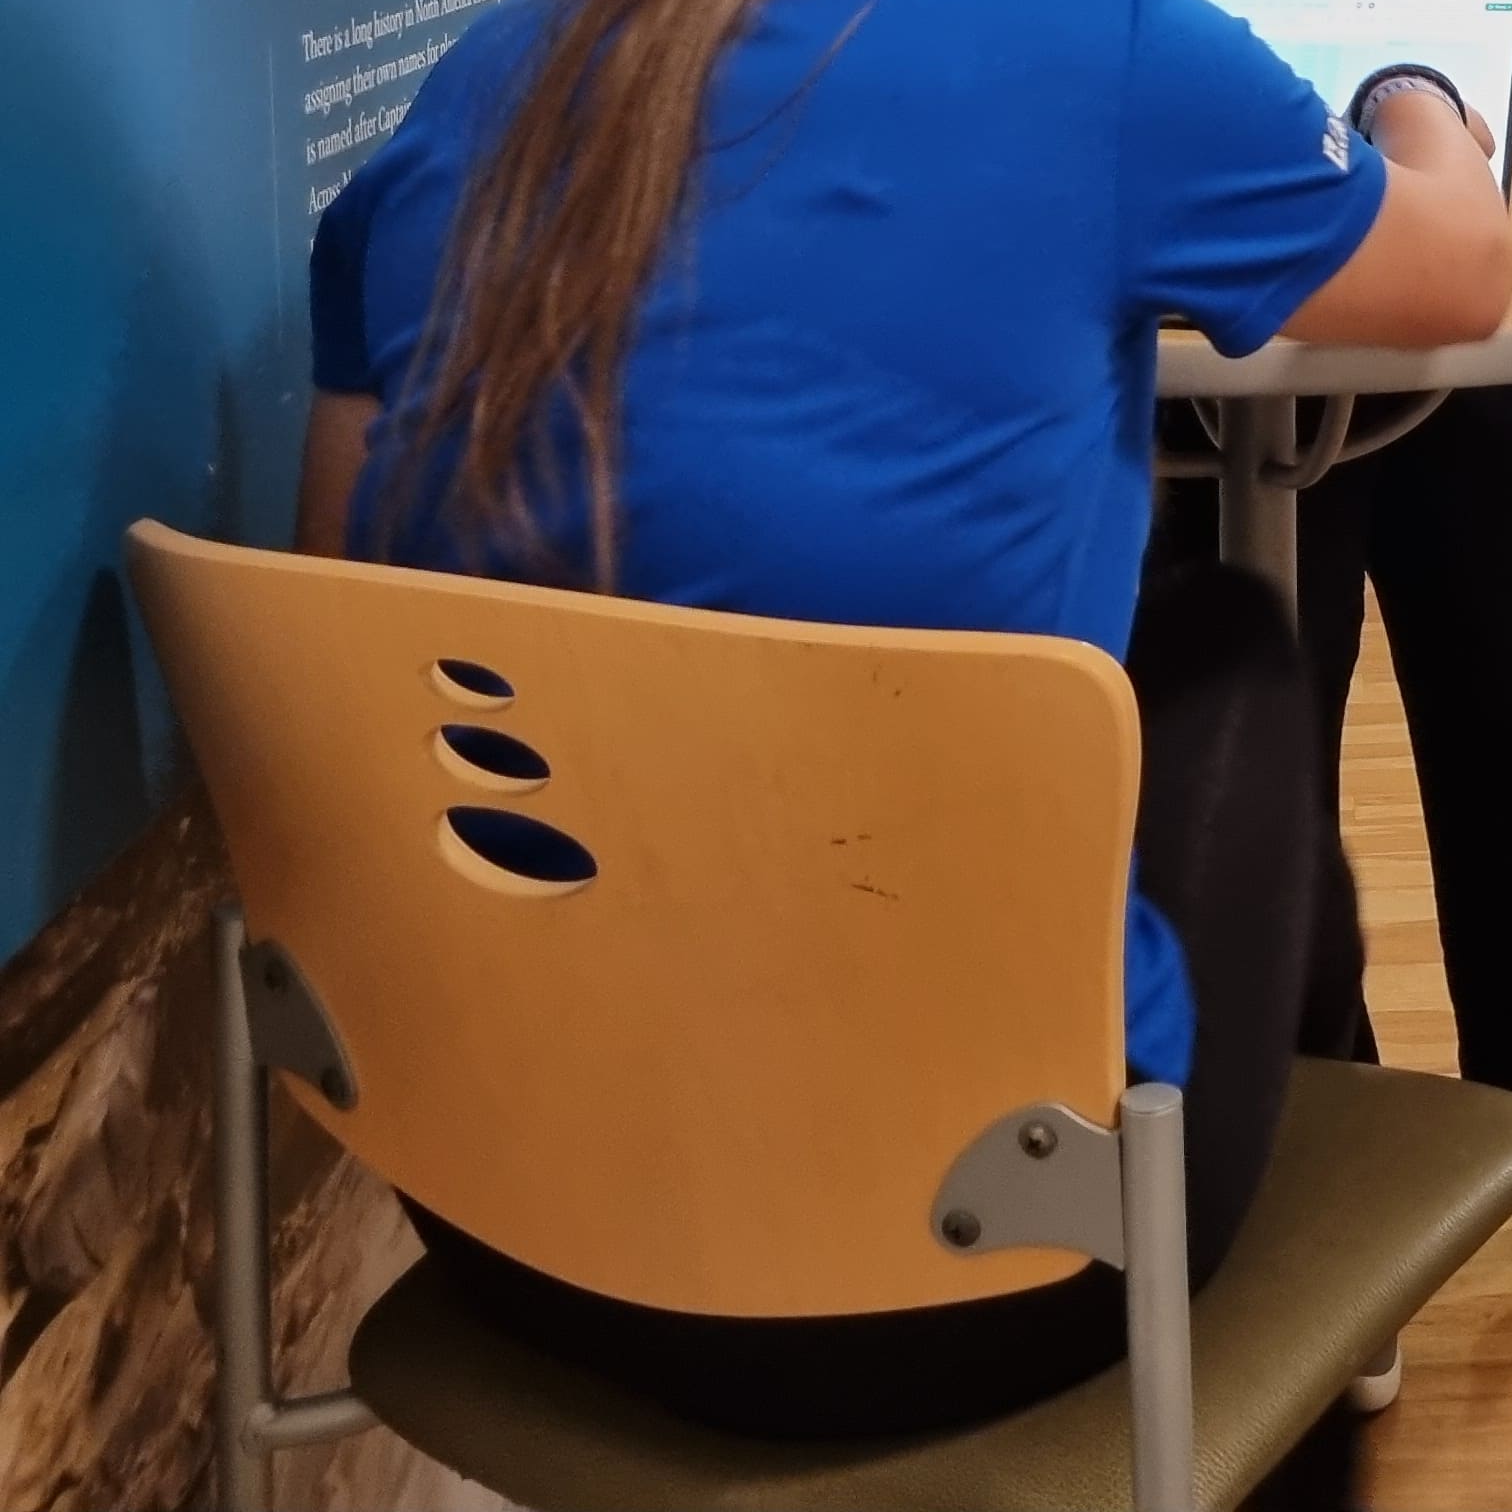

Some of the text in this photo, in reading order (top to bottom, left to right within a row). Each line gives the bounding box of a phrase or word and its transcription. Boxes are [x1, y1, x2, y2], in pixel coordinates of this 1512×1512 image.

[302, 29, 333, 63] There
[334, 24, 343, 53] is
[343, 30, 351, 48] a
[350, 16, 373, 51] long
[373, 8, 405, 41] history
[404, 7, 415, 29] in
[304, 74, 352, 116] assigning
[352, 65, 375, 96] their
[376, 63, 398, 82] own
[398, 49, 426, 77] names
[425, 37, 439, 65] for
[306, 138, 316, 165] is
[316, 118, 353, 157] named
[354, 115, 377, 144] after
